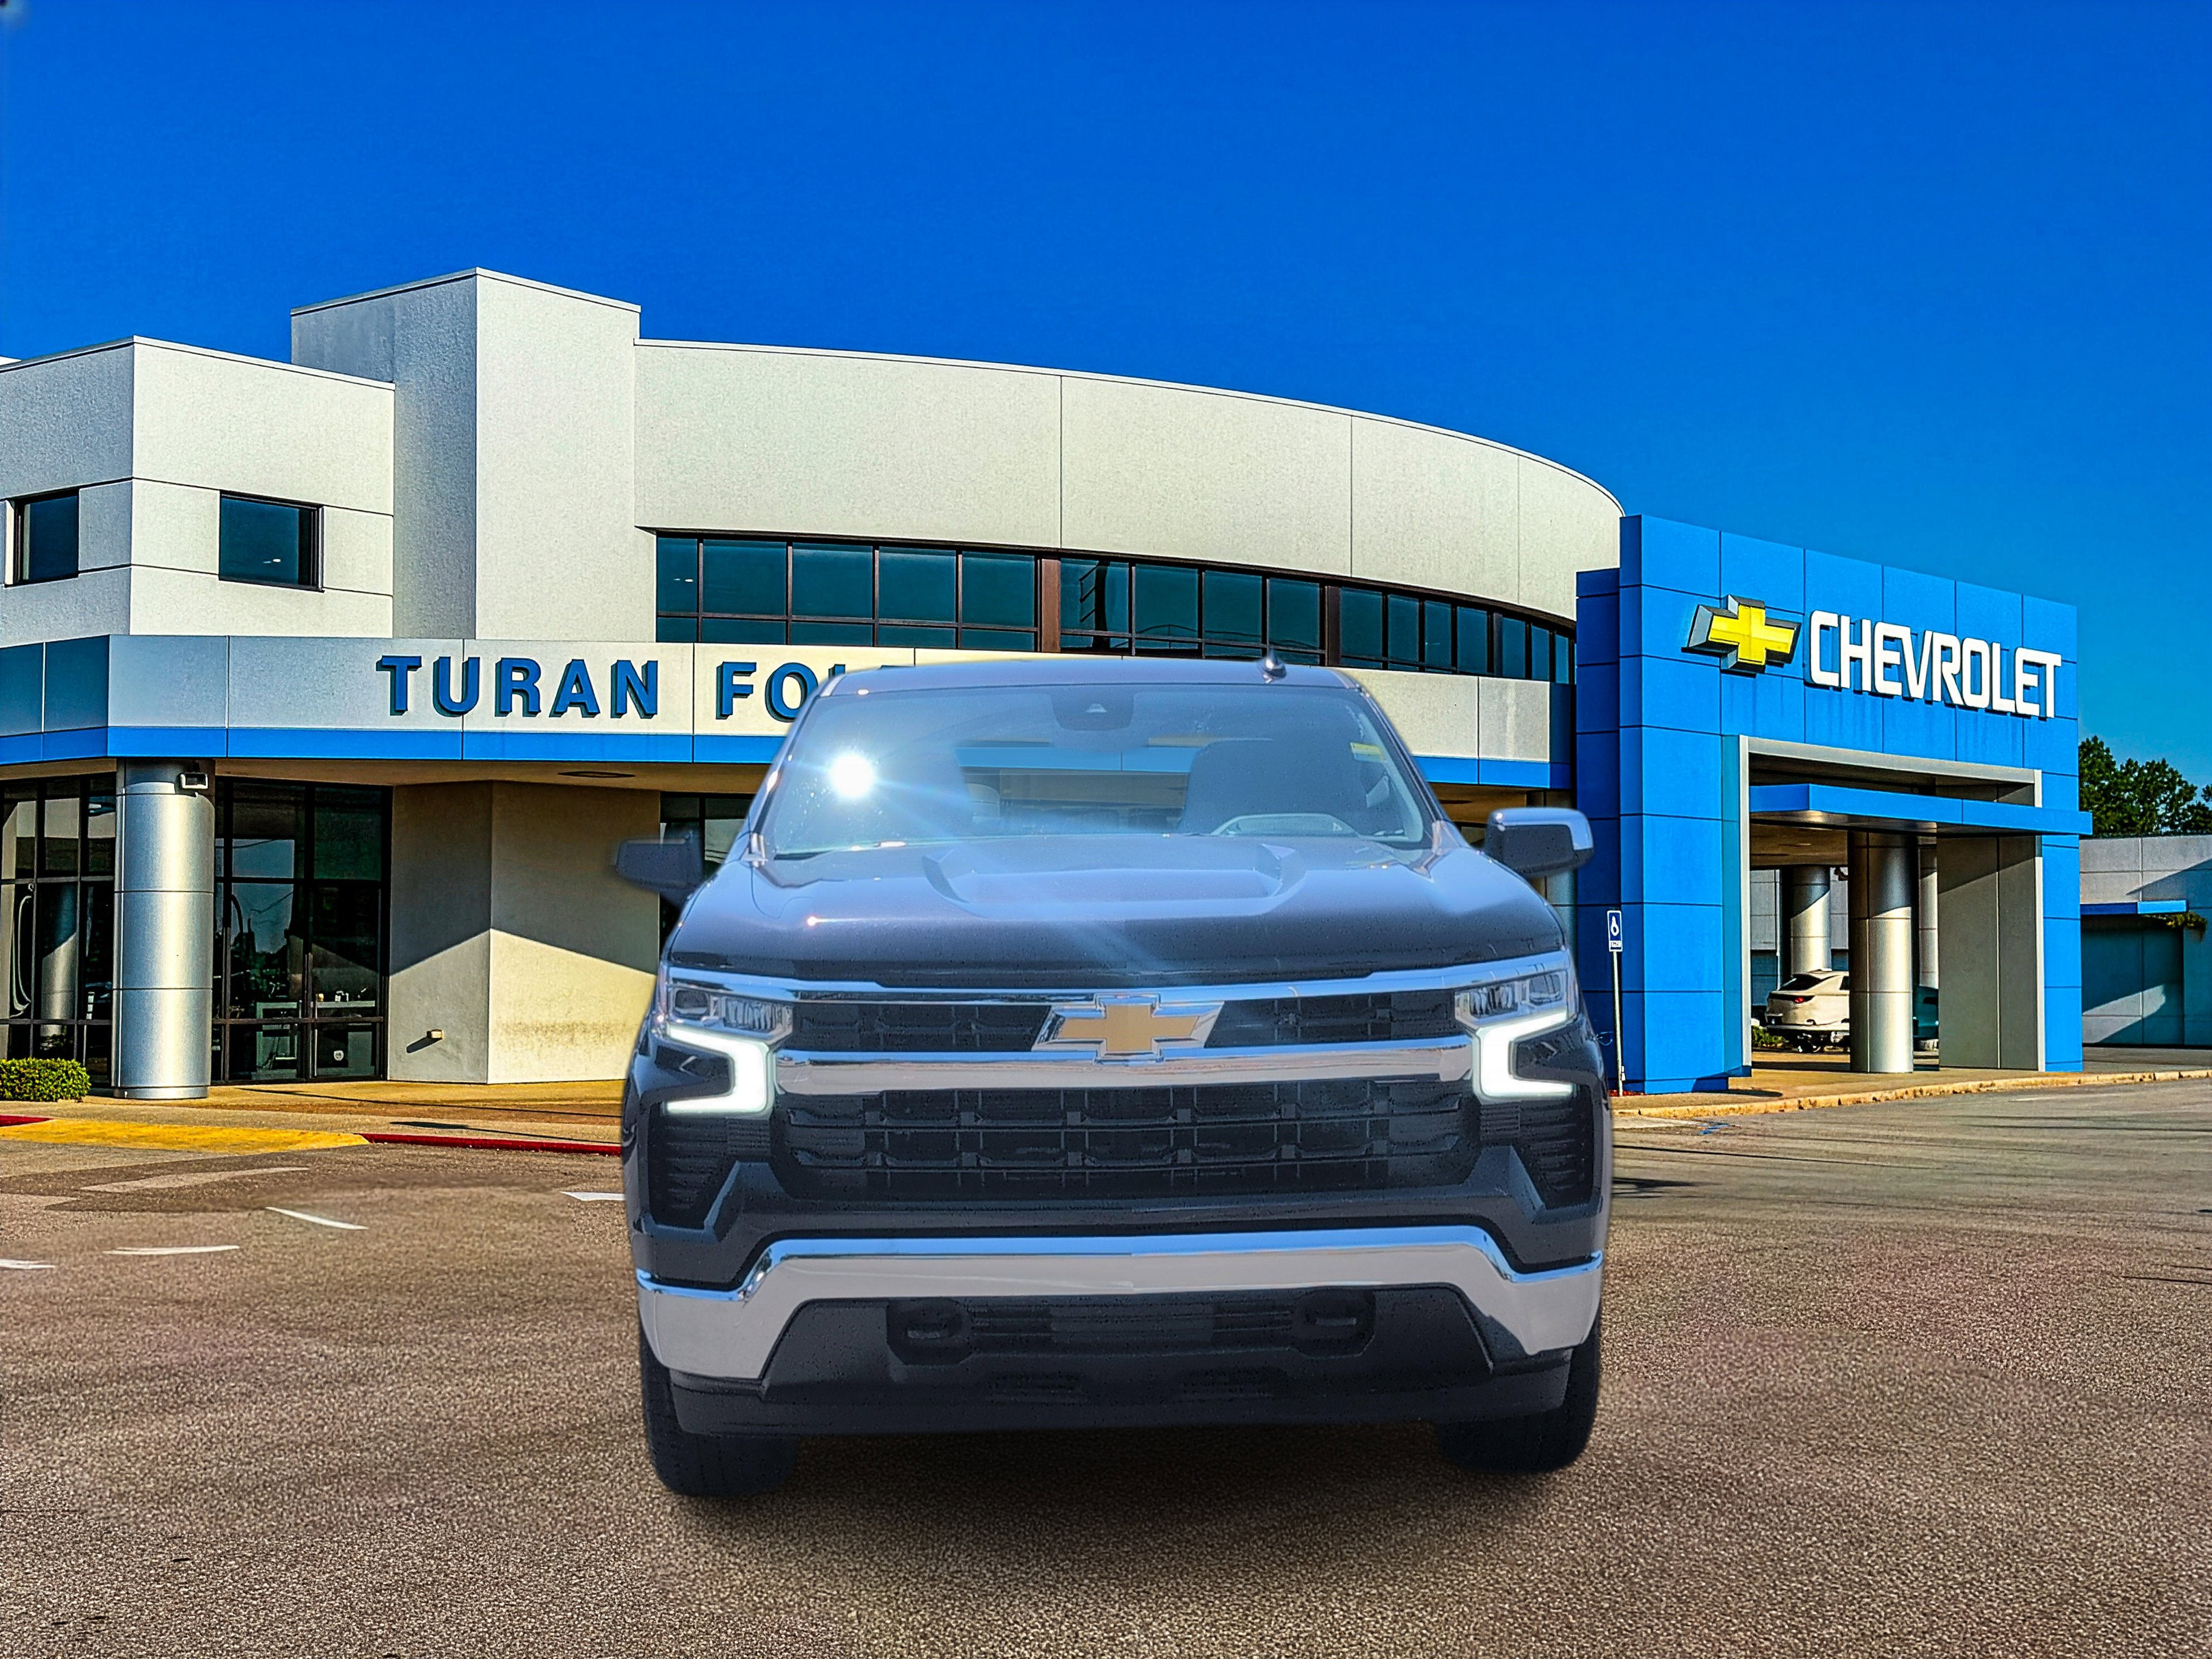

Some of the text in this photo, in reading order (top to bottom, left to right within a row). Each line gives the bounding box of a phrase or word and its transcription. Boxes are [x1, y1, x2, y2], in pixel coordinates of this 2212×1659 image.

[376, 655, 915, 723] TURAN FO
[1809, 610, 2062, 718] CHEVROLET
